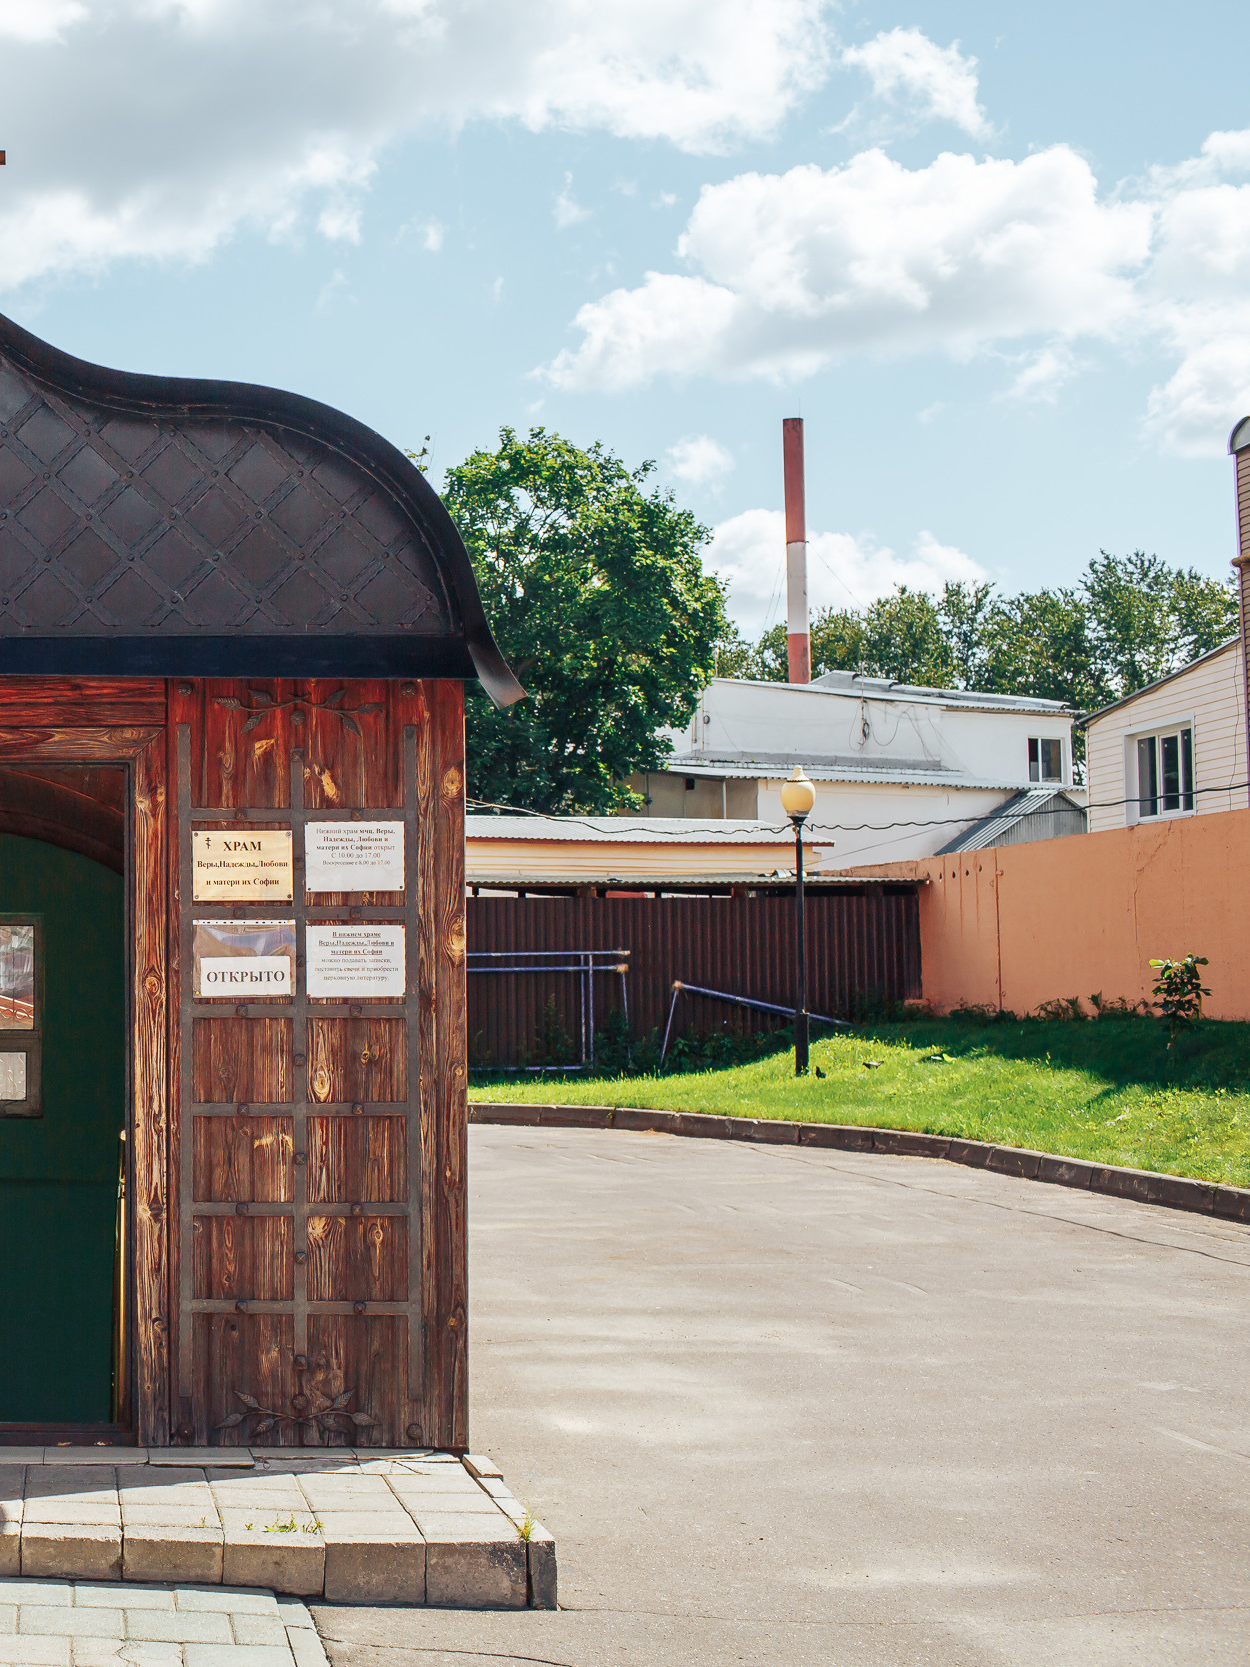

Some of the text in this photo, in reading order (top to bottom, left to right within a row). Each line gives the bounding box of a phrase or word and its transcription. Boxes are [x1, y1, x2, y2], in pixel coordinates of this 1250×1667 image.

[223, 841, 262, 851] ХРАМ
[253, 878, 279, 887] Софии
[207, 971, 285, 982] ОТКРЫТО
